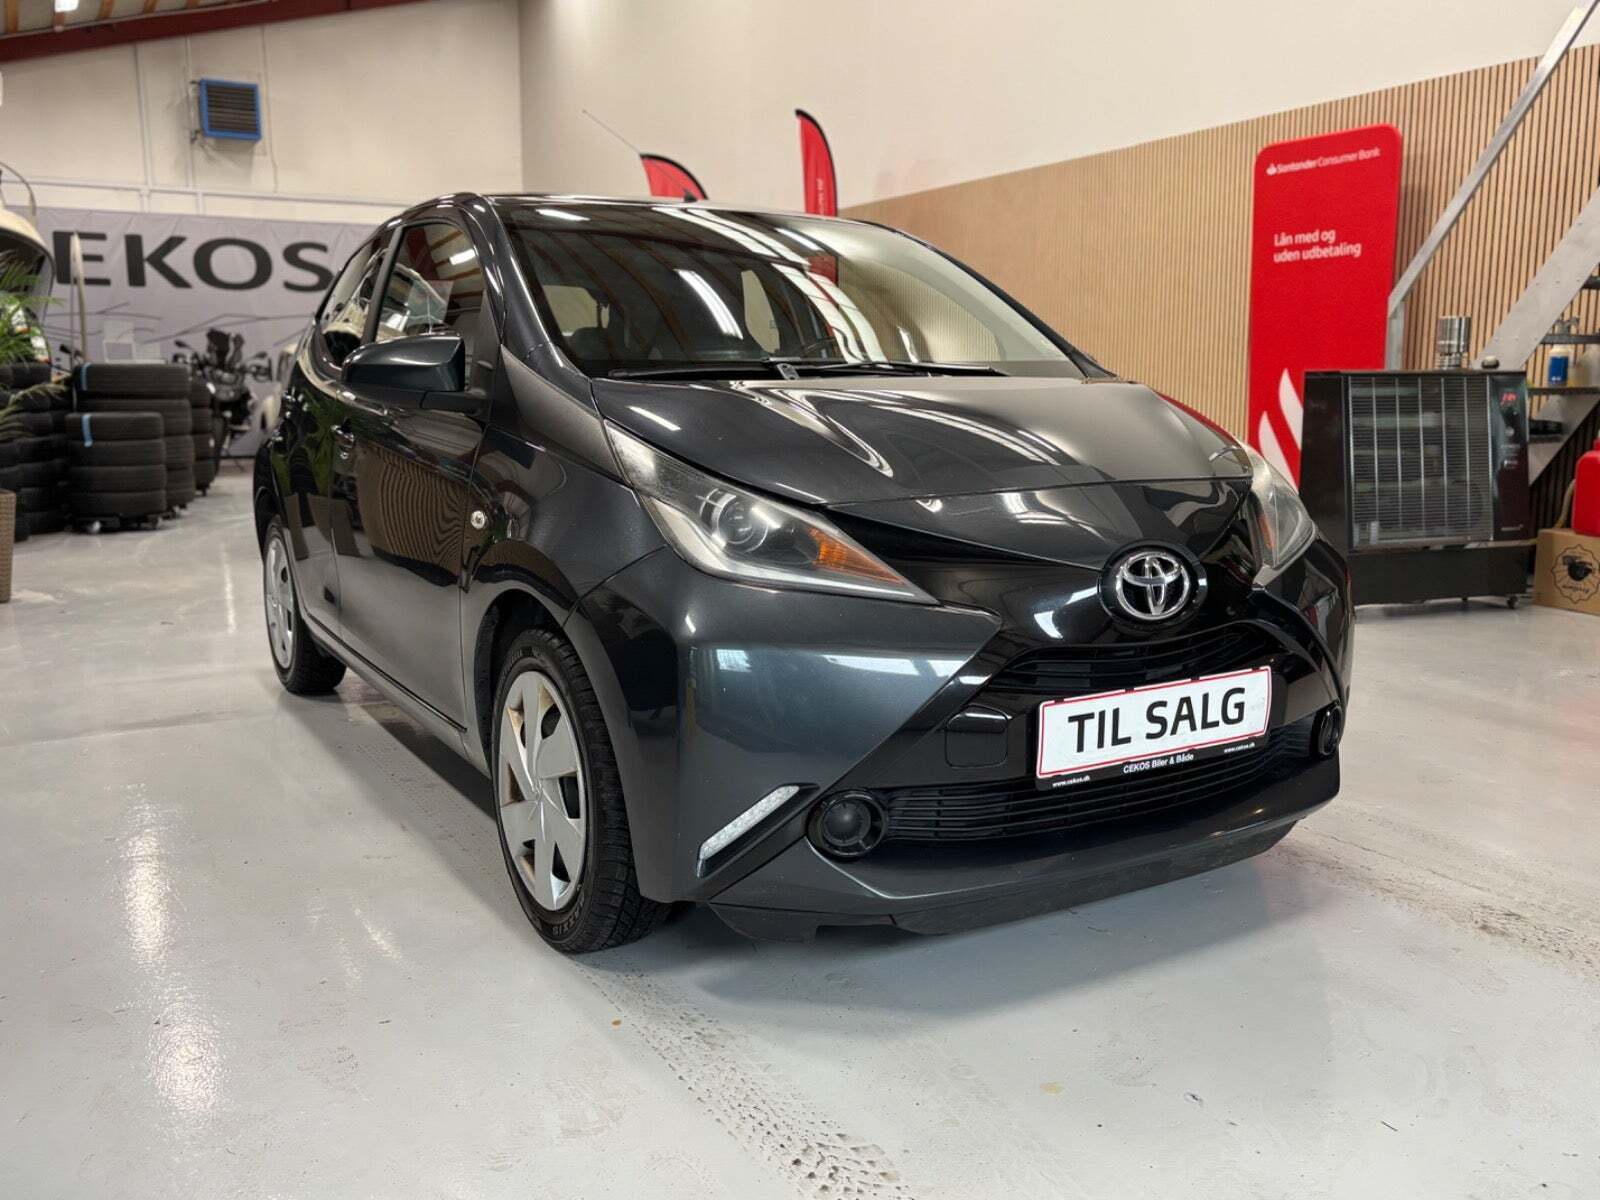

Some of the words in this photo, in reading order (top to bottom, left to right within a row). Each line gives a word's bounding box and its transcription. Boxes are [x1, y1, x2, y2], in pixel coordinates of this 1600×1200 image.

[1274, 232, 1293, 247] Lån
[1294, 230, 1319, 244] med
[1321, 230, 1336, 244] og
[53, 231, 333, 292] EKOS
[1273, 248, 1300, 263] uden
[1302, 242, 1361, 260] udbetaling
[1067, 707, 1132, 753] TIL
[1145, 687, 1246, 740] SALG
[1123, 762, 1151, 774] CEKOS
[1151, 758, 1168, 769] Biler
[1175, 753, 1195, 764] Både
